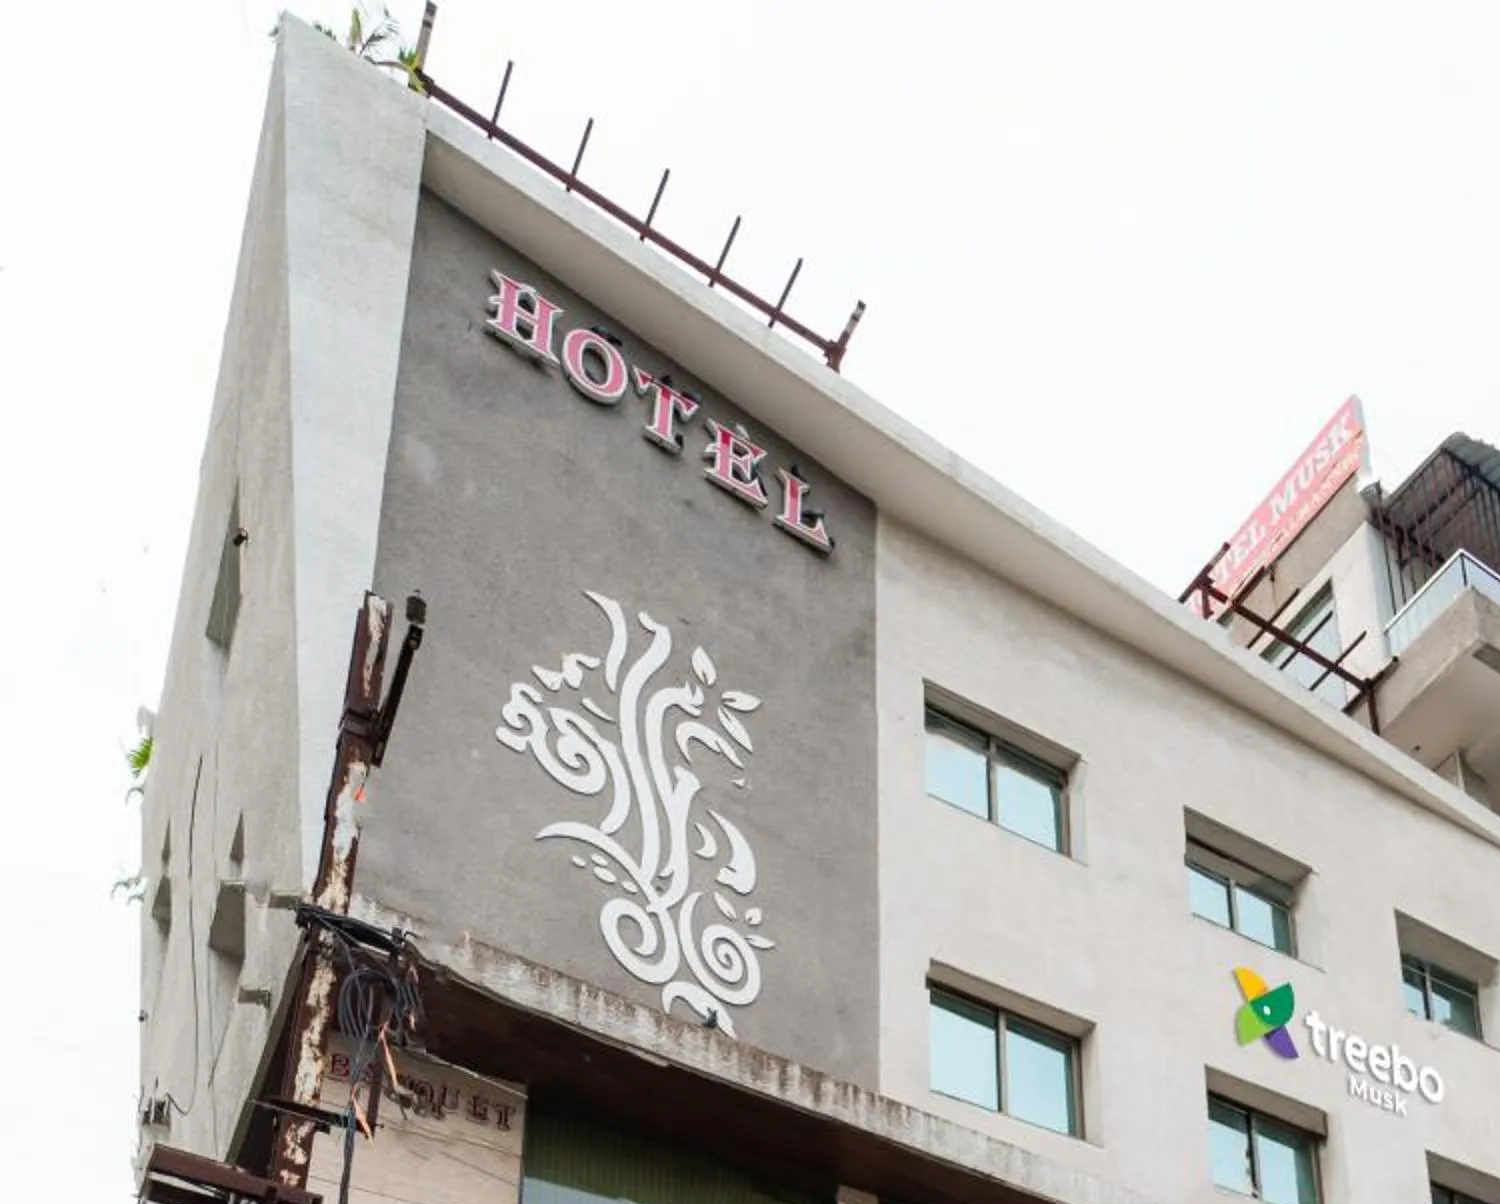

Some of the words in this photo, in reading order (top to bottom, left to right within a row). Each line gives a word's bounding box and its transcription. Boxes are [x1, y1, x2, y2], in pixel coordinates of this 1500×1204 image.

[483, 269, 834, 556] HOTEL
[1266, 411, 1354, 525] MUSK
[329, 1053, 516, 1131] BAQUET
[1305, 1010, 1443, 1103] treebo
[1350, 1075, 1407, 1116] Musk
